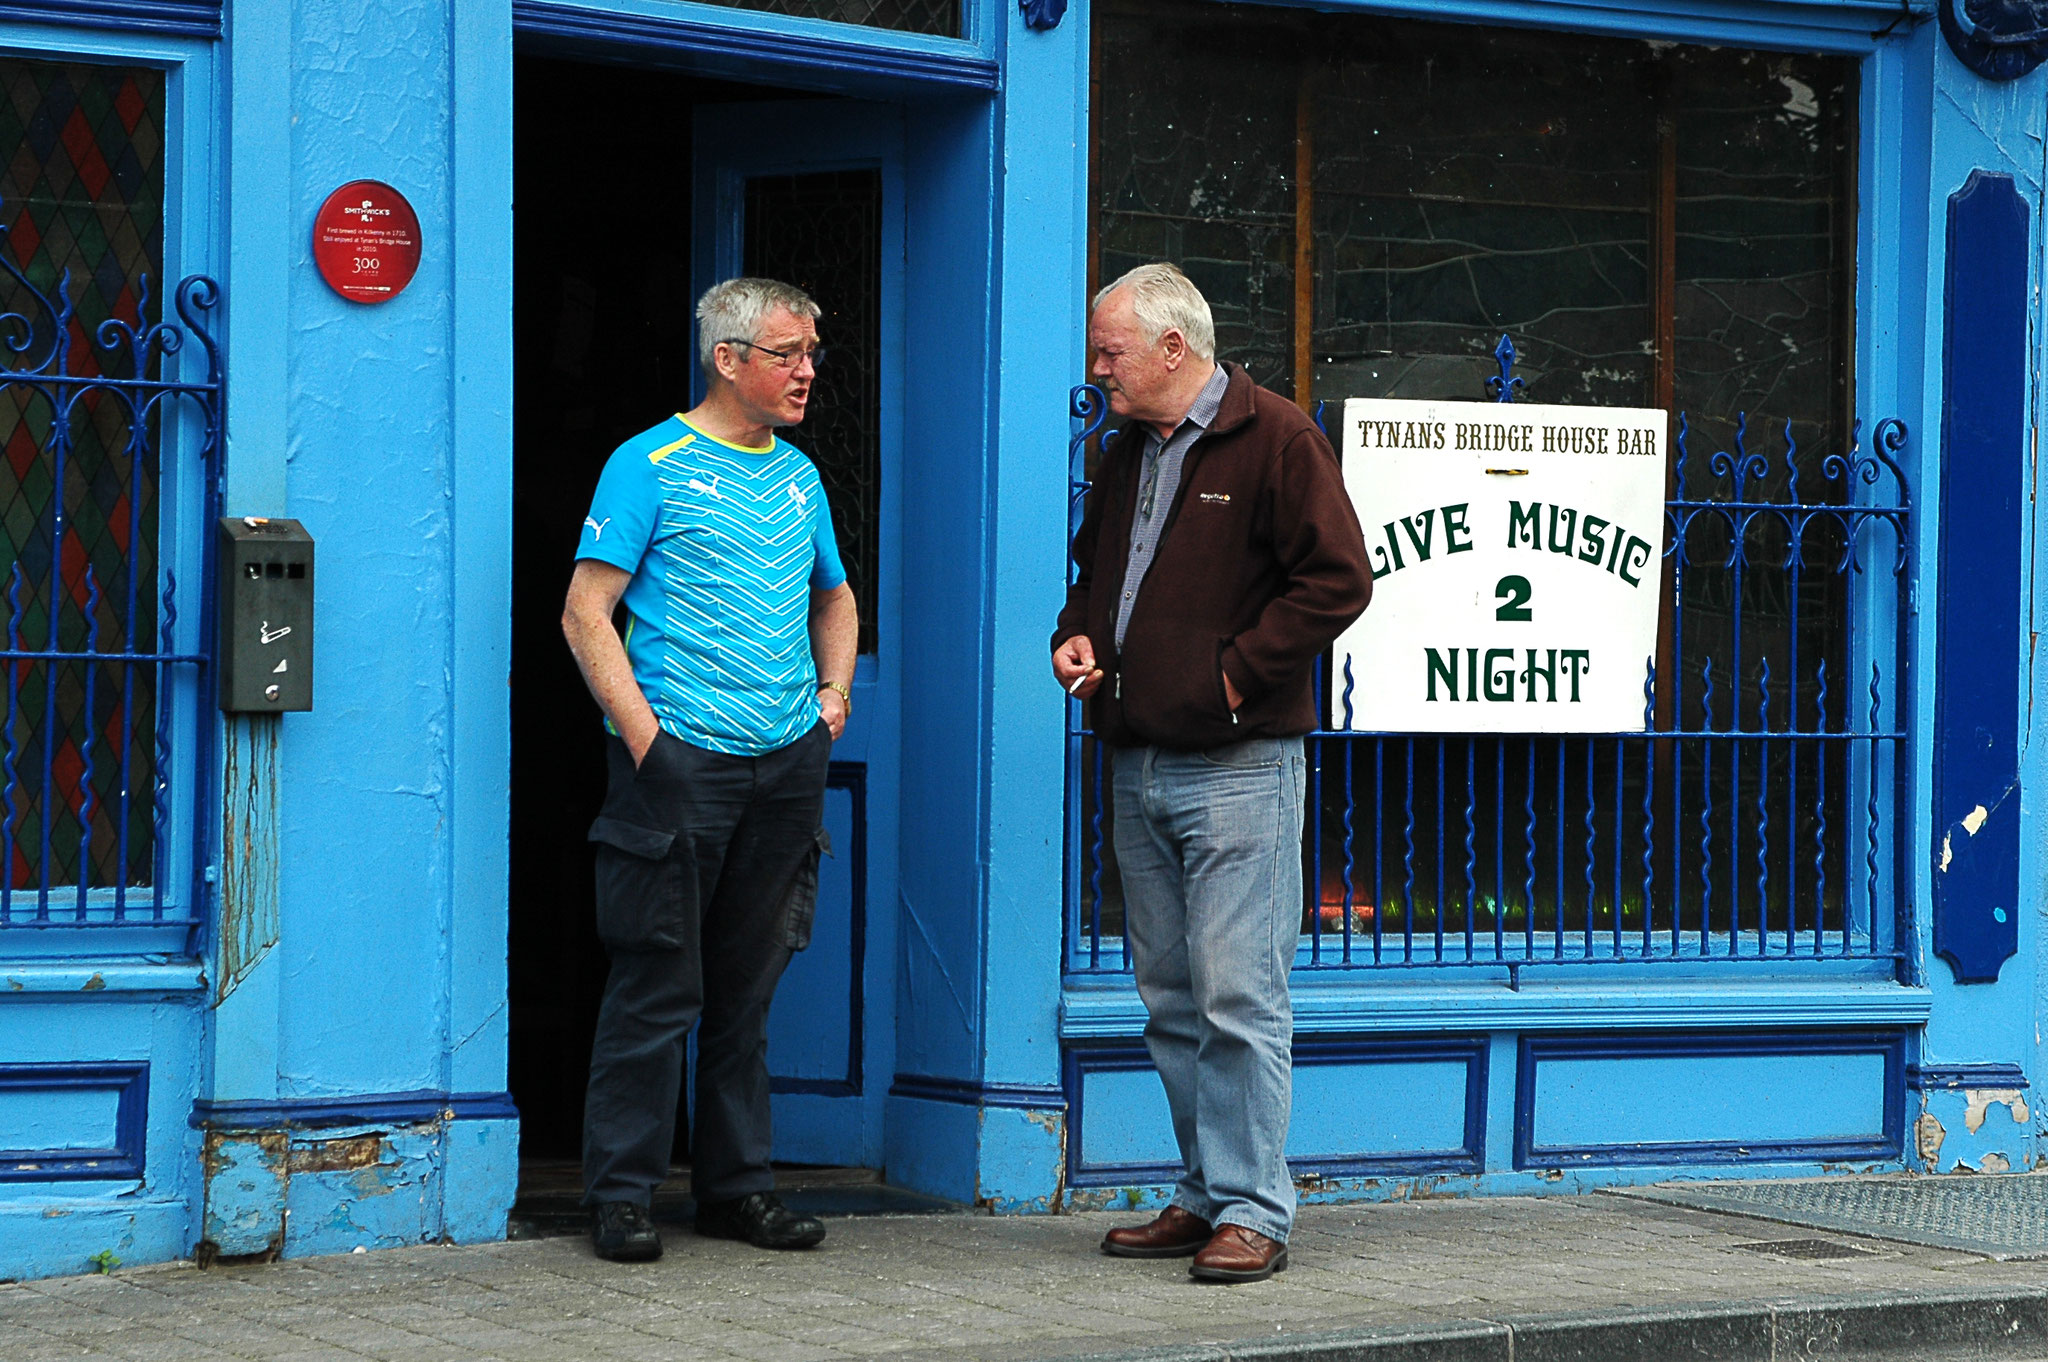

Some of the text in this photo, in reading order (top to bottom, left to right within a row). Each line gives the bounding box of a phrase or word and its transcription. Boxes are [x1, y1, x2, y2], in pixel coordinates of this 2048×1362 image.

[344, 207, 390, 216] SMITHWICK'S
[352, 257, 380, 274] 300
[1358, 420, 1657, 456] TYNANS BRIDGE HOUSE BAR
[1370, 500, 1653, 588] LIVE MUSIC
[1495, 574, 1532, 622] 2
[1424, 647, 1590, 702] NIGHT
